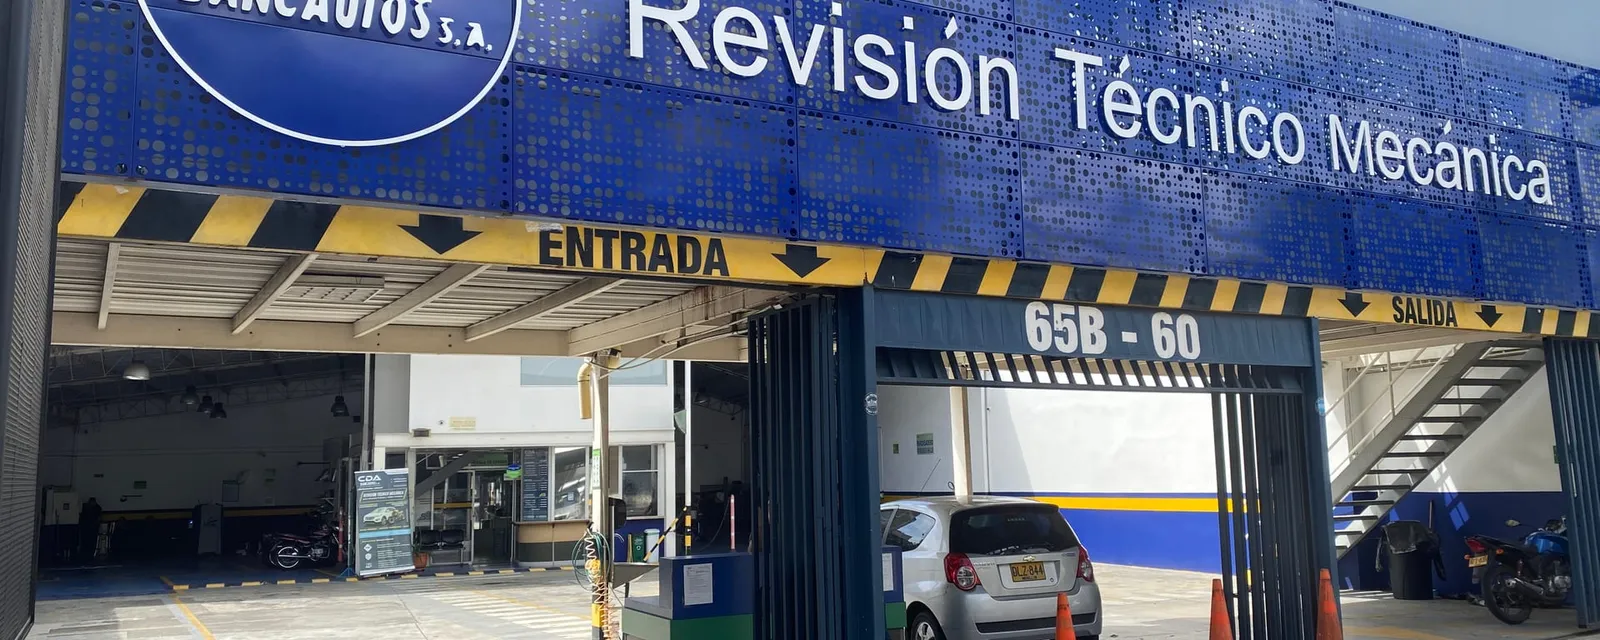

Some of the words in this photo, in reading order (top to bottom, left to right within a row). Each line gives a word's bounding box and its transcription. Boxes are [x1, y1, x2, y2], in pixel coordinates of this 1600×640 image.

[182, 0, 432, 39] AUTOS
[628, 0, 1020, 121] Revisión
[1055, 47, 1305, 165] Técnico
[1329, 113, 1553, 206] Mecánica
[538, 226, 730, 277] ENTRADA
[1024, 301, 1108, 355] 65B
[1151, 311, 1201, 360] 60
[1392, 295, 1459, 328] SALIDA
